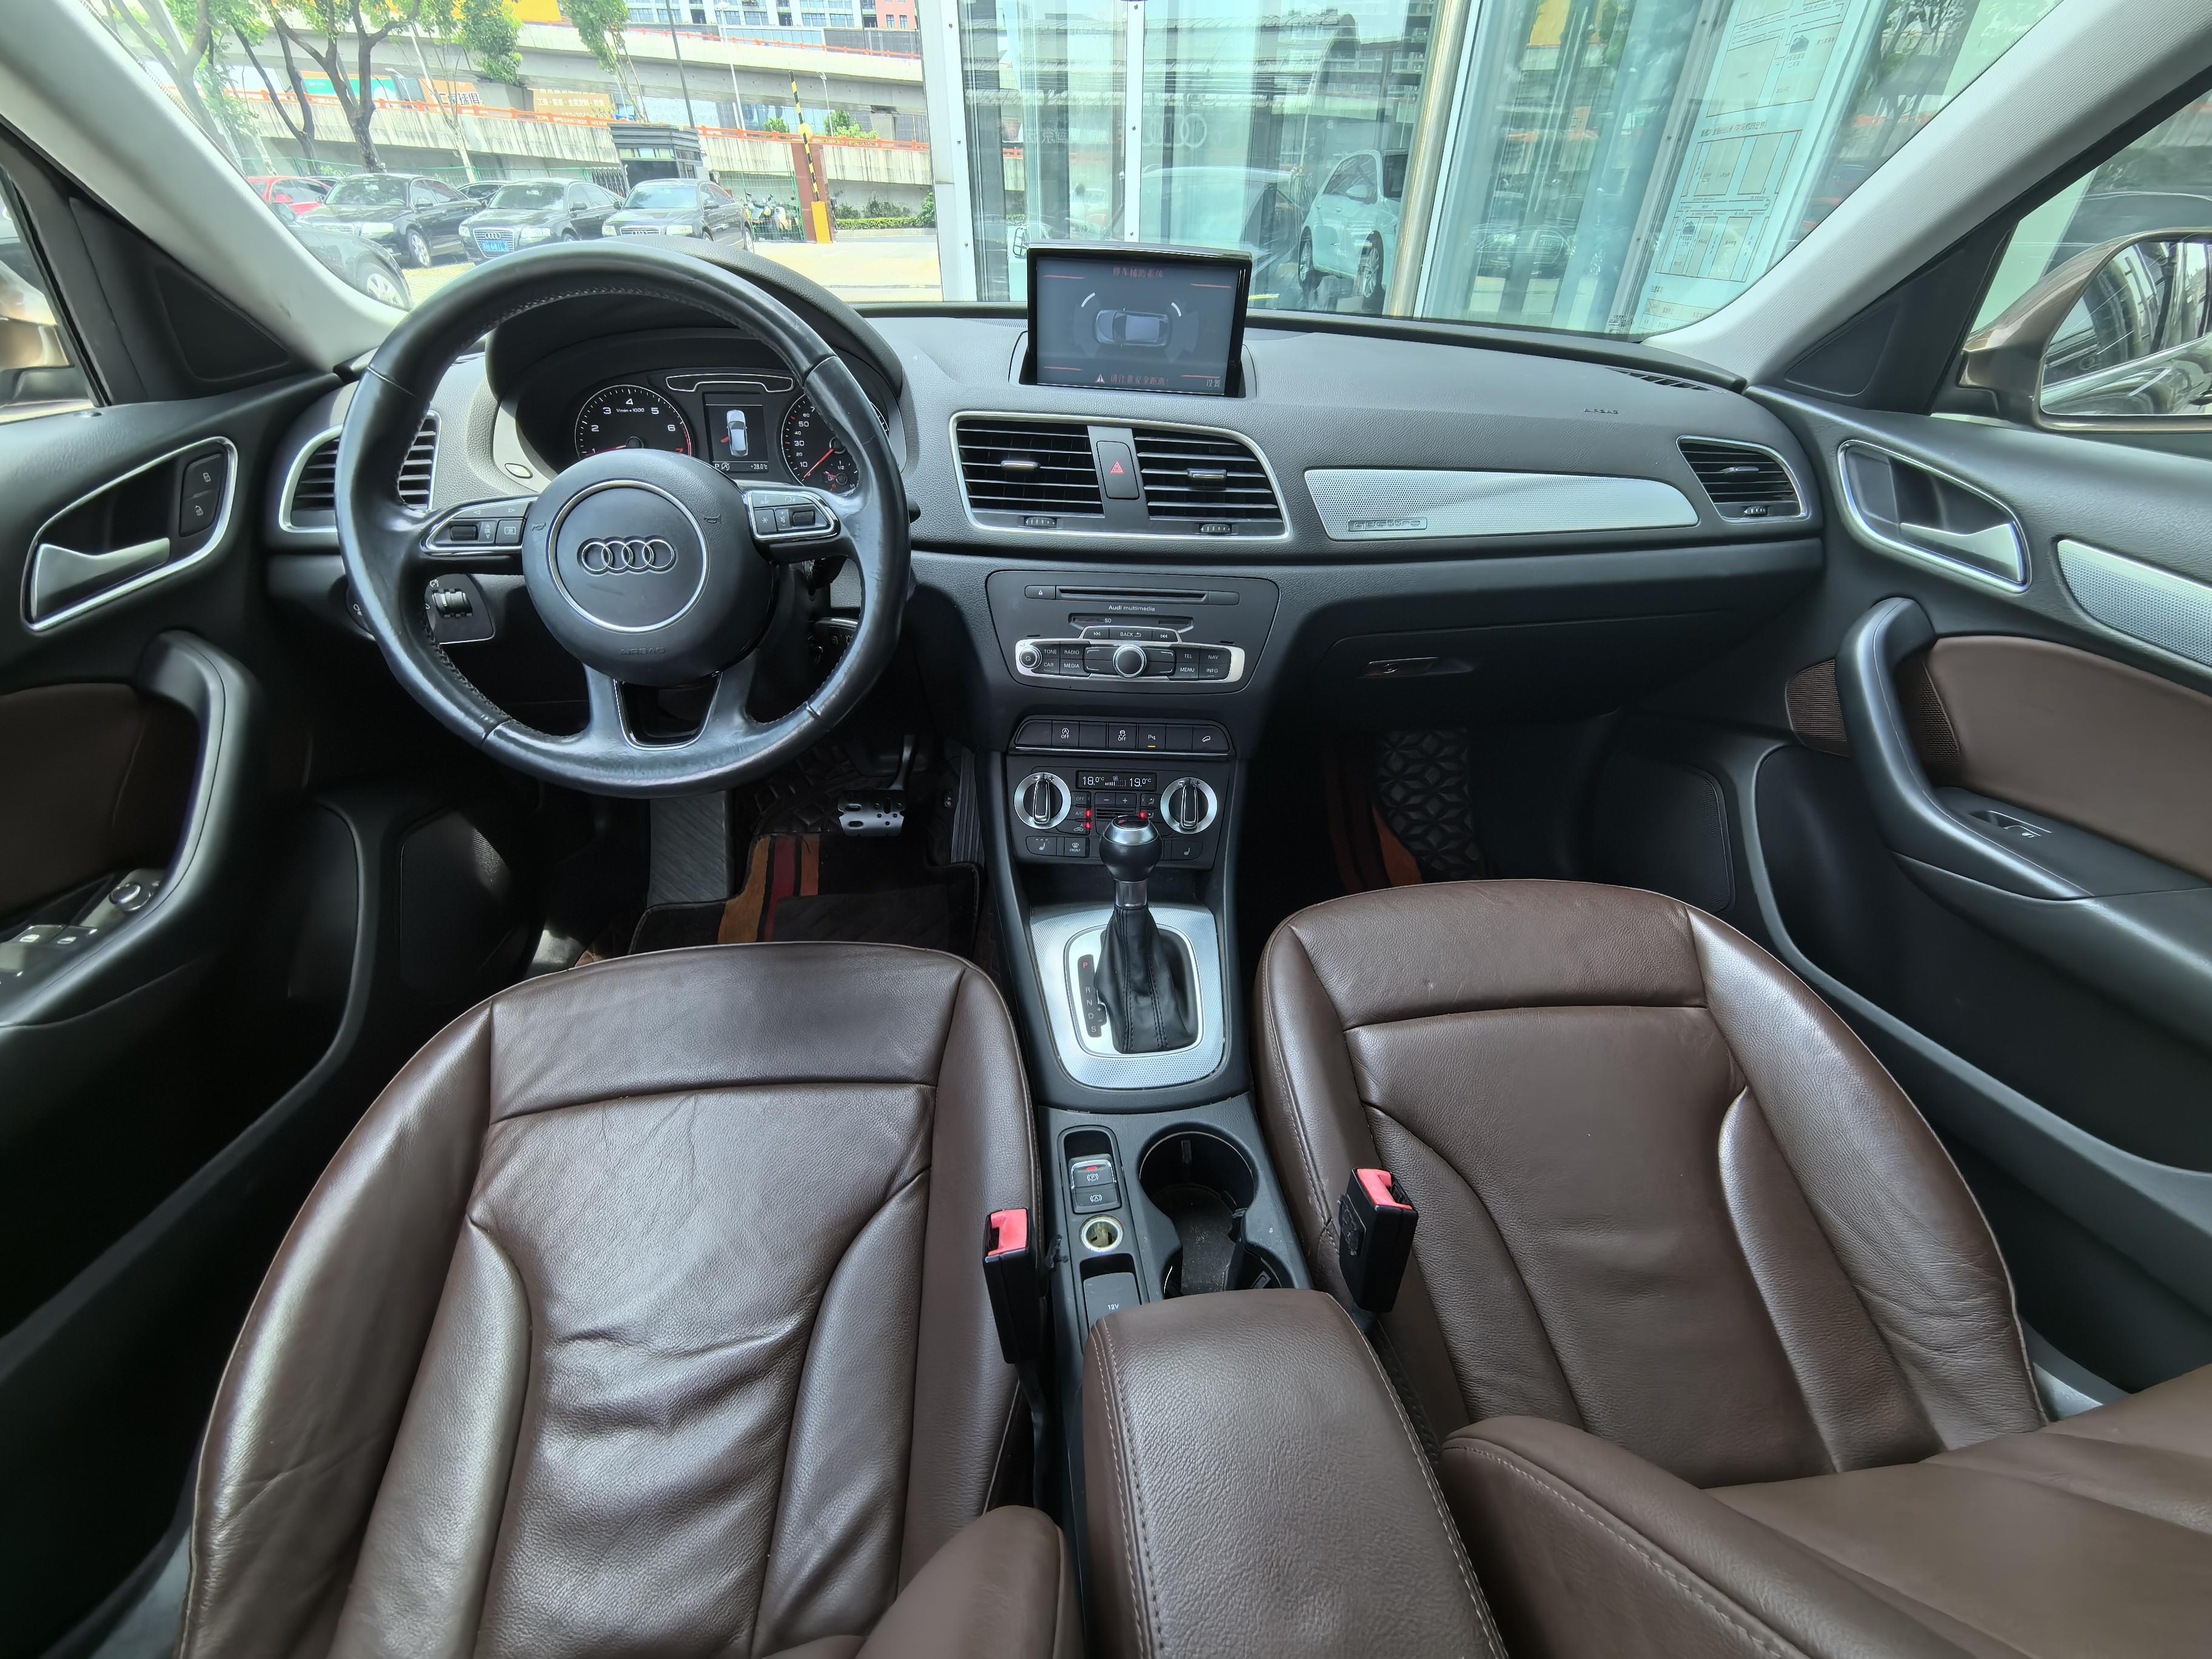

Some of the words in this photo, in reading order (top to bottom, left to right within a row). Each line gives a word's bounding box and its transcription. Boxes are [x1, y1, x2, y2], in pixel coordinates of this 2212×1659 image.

[1353, 520, 1421, 531] quattro
[1082, 776, 1105, 786] 18.0°C
[1130, 777, 1151, 787] 19.0°C
